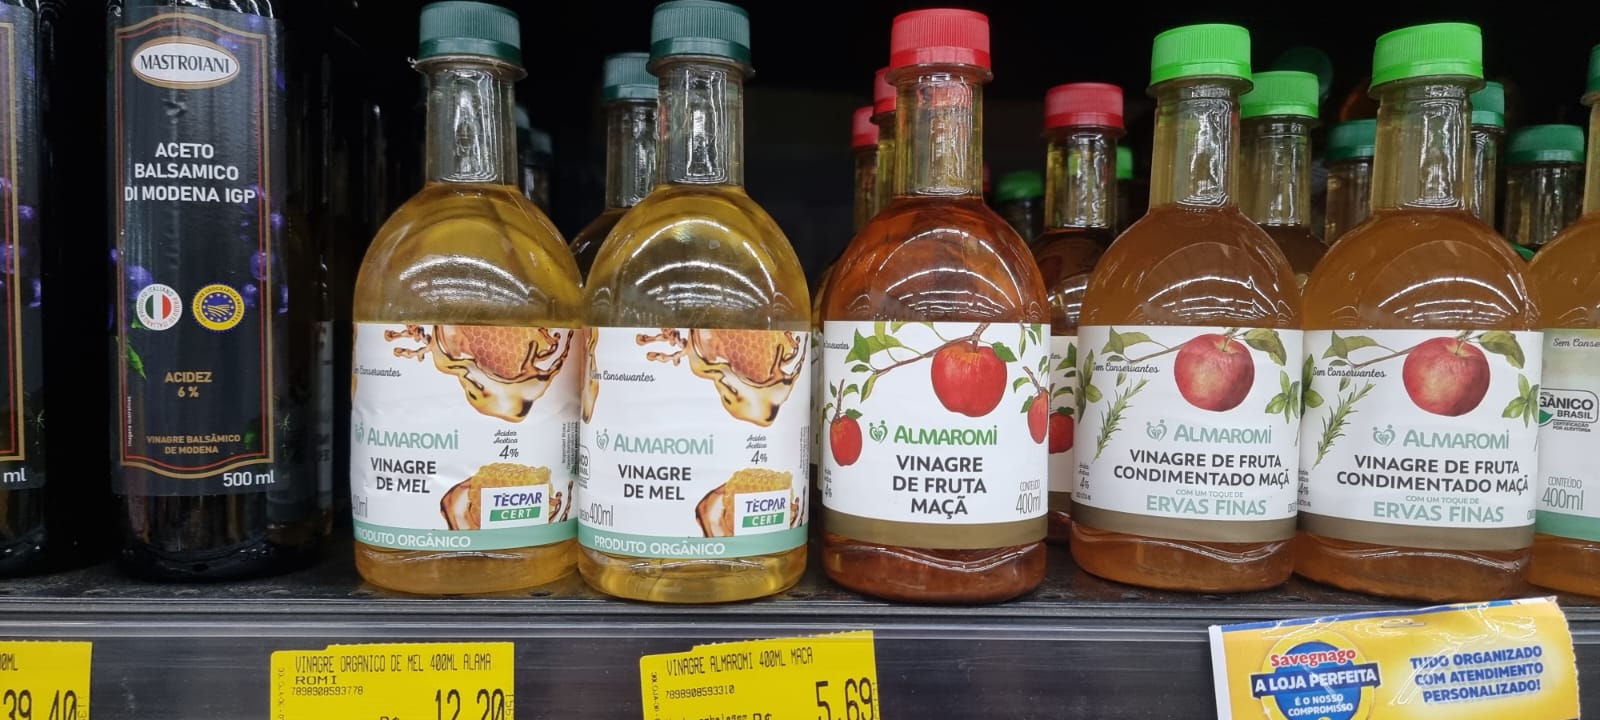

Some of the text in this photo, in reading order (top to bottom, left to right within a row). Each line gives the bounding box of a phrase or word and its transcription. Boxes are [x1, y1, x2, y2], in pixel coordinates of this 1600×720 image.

[140, 54, 230, 74] MASTROIANI
[155, 142, 214, 159] ACETO
[134, 163, 239, 181] BALSAMICO
[124, 186, 256, 204] DI MODENA IGP
[1553, 337, 1570, 347] Sem
[164, 371, 213, 383] ACIDEZ
[603, 370, 655, 382] Conservantes
[1105, 362, 1160, 375] Conservantes
[1327, 366, 1387, 379] Conservantes
[177, 387, 199, 398] 6 %
[1540, 394, 1594, 410] GÂNICO
[1556, 410, 1593, 420] BRASIL
[146, 433, 241, 445] VINAGRE BALSÂMICO
[164, 446, 219, 455] DE MODENA
[499, 445, 519, 460] 4%
[751, 450, 768, 464] 4%
[1130, 449, 1282, 468] VINAGRE DE FRUTA
[370, 457, 437, 475] VINAGRE
[617, 463, 692, 481] VINAGRE
[896, 455, 984, 473] VINAGRE
[1354, 455, 1520, 475] VINAGRE DE FRUTA
[4, 468, 27, 483] ml
[223, 470, 275, 487] 500 ml
[1114, 465, 1255, 487] CONDIMENTADO
[1258, 468, 1290, 490] MAÇÃ
[1337, 471, 1529, 497] CONDIMENTADO MAÇÃ
[1548, 476, 1582, 489] CONTEÚDO
[376, 477, 431, 494] DE MEL
[623, 483, 686, 501] DE MEL
[893, 476, 987, 494] DE FRUTA
[1209, 490, 1233, 498] TOQUE
[1426, 496, 1440, 504] UM
[1442, 496, 1468, 506] TOQUE
[1542, 487, 1584, 511] 400ml
[910, 496, 968, 520] MAÇÃ
[1016, 492, 1041, 515] 400ml
[1146, 495, 1209, 515] ERVAS
[1216, 499, 1267, 516] FINAS
[1373, 501, 1504, 523] ERVAS FINAS
[500, 508, 532, 520] CERT
[590, 502, 614, 527] 400ml
[752, 514, 778, 526] CERT
[398, 532, 471, 548] ORGÂNICO
[594, 536, 726, 556] PRODUTO ORGÂNICO
[295, 653, 492, 674] VINAGRE ORGANICO DE MEL 400ML ALAMA
[666, 646, 814, 676] VINAGRE ALMAROMI 400ML MACA
[1270, 649, 1356, 667] Savegnago
[1410, 645, 1542, 670] TUDO ORGANIZADO
[295, 675, 337, 686] ROMI
[1254, 668, 1378, 692] A LOJA PERFEITA
[1415, 662, 1544, 686] COM ATENDIMENTO
[292, 686, 364, 697] 7898908593778
[664, 684, 735, 700] 7898908593310
[1294, 696, 1300, 706] É
[1312, 694, 1344, 704] NOSSO
[1423, 680, 1541, 703] PERSONALIZADO!
[1288, 702, 1354, 716] COMPROMISSO
